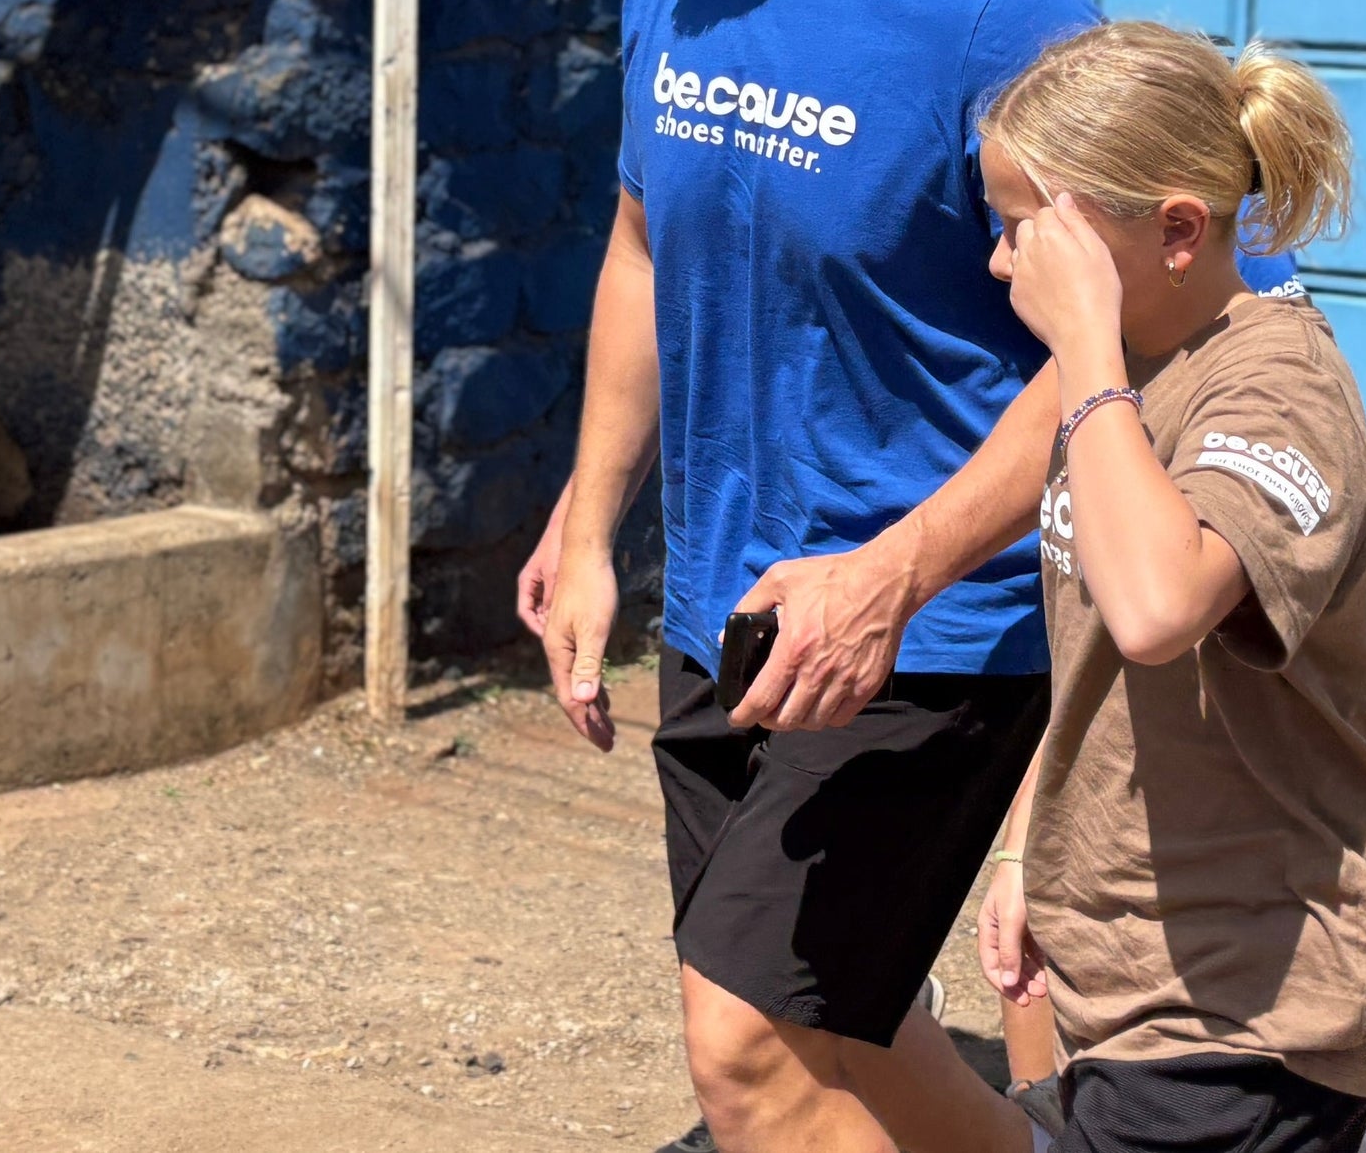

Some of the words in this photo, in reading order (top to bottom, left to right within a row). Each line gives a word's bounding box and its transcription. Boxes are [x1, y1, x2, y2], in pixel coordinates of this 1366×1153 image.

[653, 51, 857, 146] be.cause
[655, 105, 724, 145] shoes
[1203, 431, 1330, 513] be.cause
